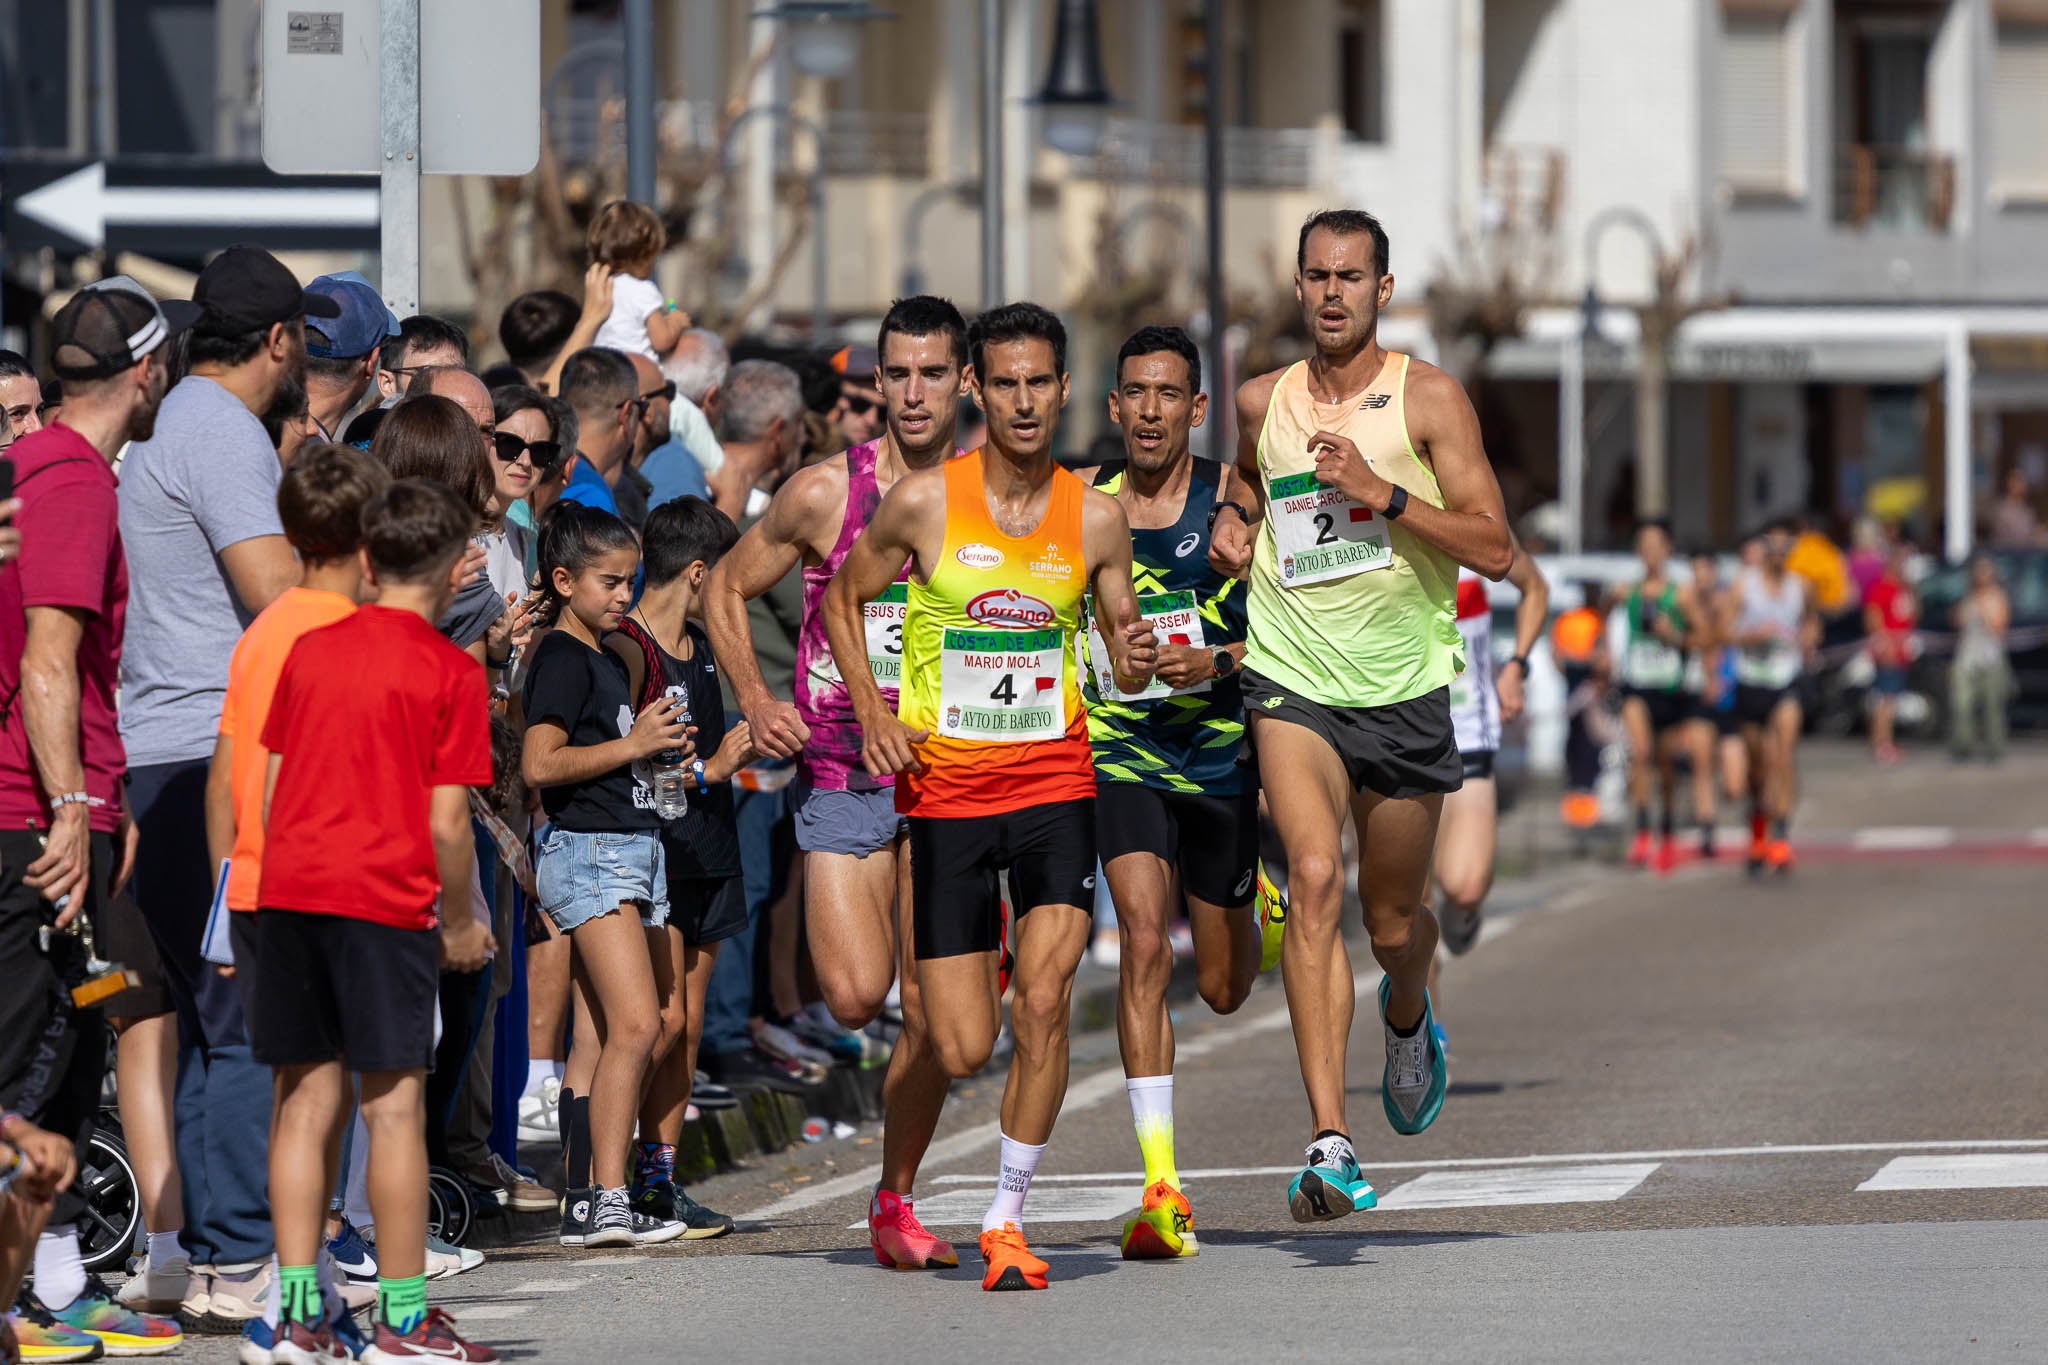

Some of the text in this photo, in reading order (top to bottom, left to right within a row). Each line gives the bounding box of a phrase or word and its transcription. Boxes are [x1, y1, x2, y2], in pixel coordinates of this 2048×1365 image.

[1272, 479, 1306, 498] COSTA
[1284, 496, 1318, 514] DANIEL
[1313, 513, 1339, 545] 2
[960, 548, 999, 563] Serrano
[1295, 541, 1380, 574] AYTO DE BAREYO
[1029, 561, 1072, 574] SERRANO
[864, 603, 894, 618] ESÚS
[975, 600, 1048, 623] Serrano
[1152, 612, 1191, 630] ASSEM
[883, 624, 903, 655] 3
[949, 632, 997, 650] COSTA
[1006, 635, 1025, 651] DE
[869, 660, 900, 677] TO DE
[964, 655, 1041, 669] MARIO MOLA
[990, 673, 1018, 705] 4
[961, 711, 1052, 730] AYTO DE BAREYO
